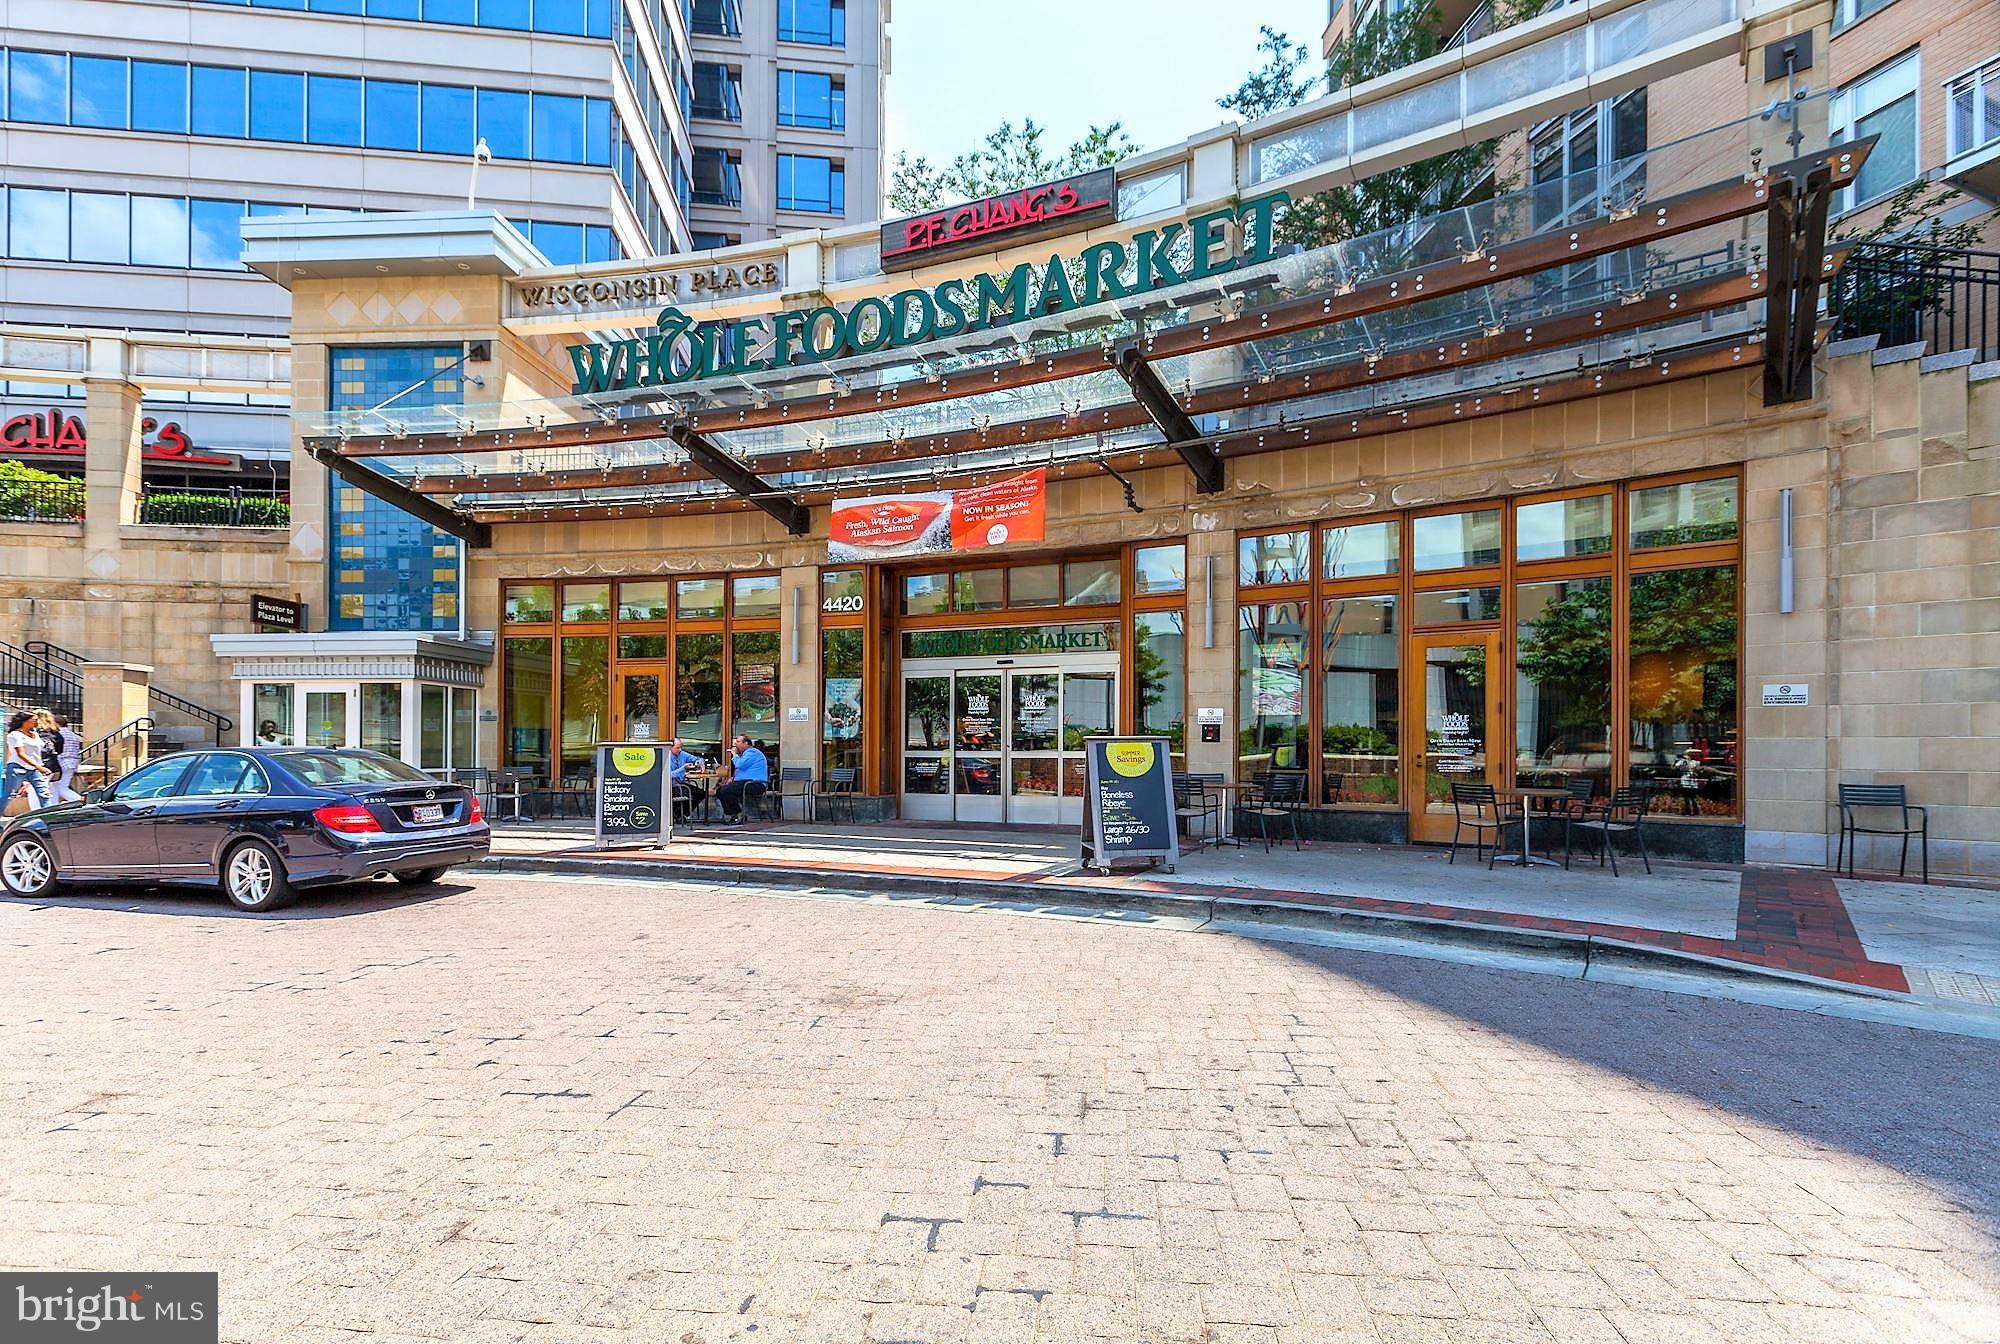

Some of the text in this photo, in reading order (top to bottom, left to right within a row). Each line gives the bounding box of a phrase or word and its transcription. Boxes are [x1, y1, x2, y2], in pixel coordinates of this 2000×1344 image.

[905, 182, 1079, 248] P.F. CHANG'S
[520, 262, 777, 307] WISCONSIN PLACE
[566, 191, 1292, 394] WHOLE FOODS MARKET
[963, 505, 983, 515] NOW
[995, 500, 1029, 511] SEASON!
[845, 513, 920, 530] Fresh, Wild Caught
[851, 524, 914, 538] Alaskan Salmon
[258, 602, 286, 613] Elevator
[823, 595, 864, 611] 4420
[257, 611, 294, 624] Plaza Level
[1028, 630, 1102, 650] MARKET
[1024, 693, 1047, 701] WHOLE
[1441, 712, 1470, 721] WHOLE
[1443, 720, 1469, 728] FOODS
[624, 752, 645, 761] Sale
[1116, 755, 1146, 764] Savings
[604, 785, 632, 794] Hickory
[1101, 790, 1134, 799] Boneless
[603, 794, 634, 803] Smoked
[1102, 798, 1126, 808] Ribeye
[603, 802, 630, 811] Bacon
[1102, 813, 1120, 821] Save
[1103, 825, 1151, 836] Large 26/30
[1104, 834, 1133, 845] Shrimp
